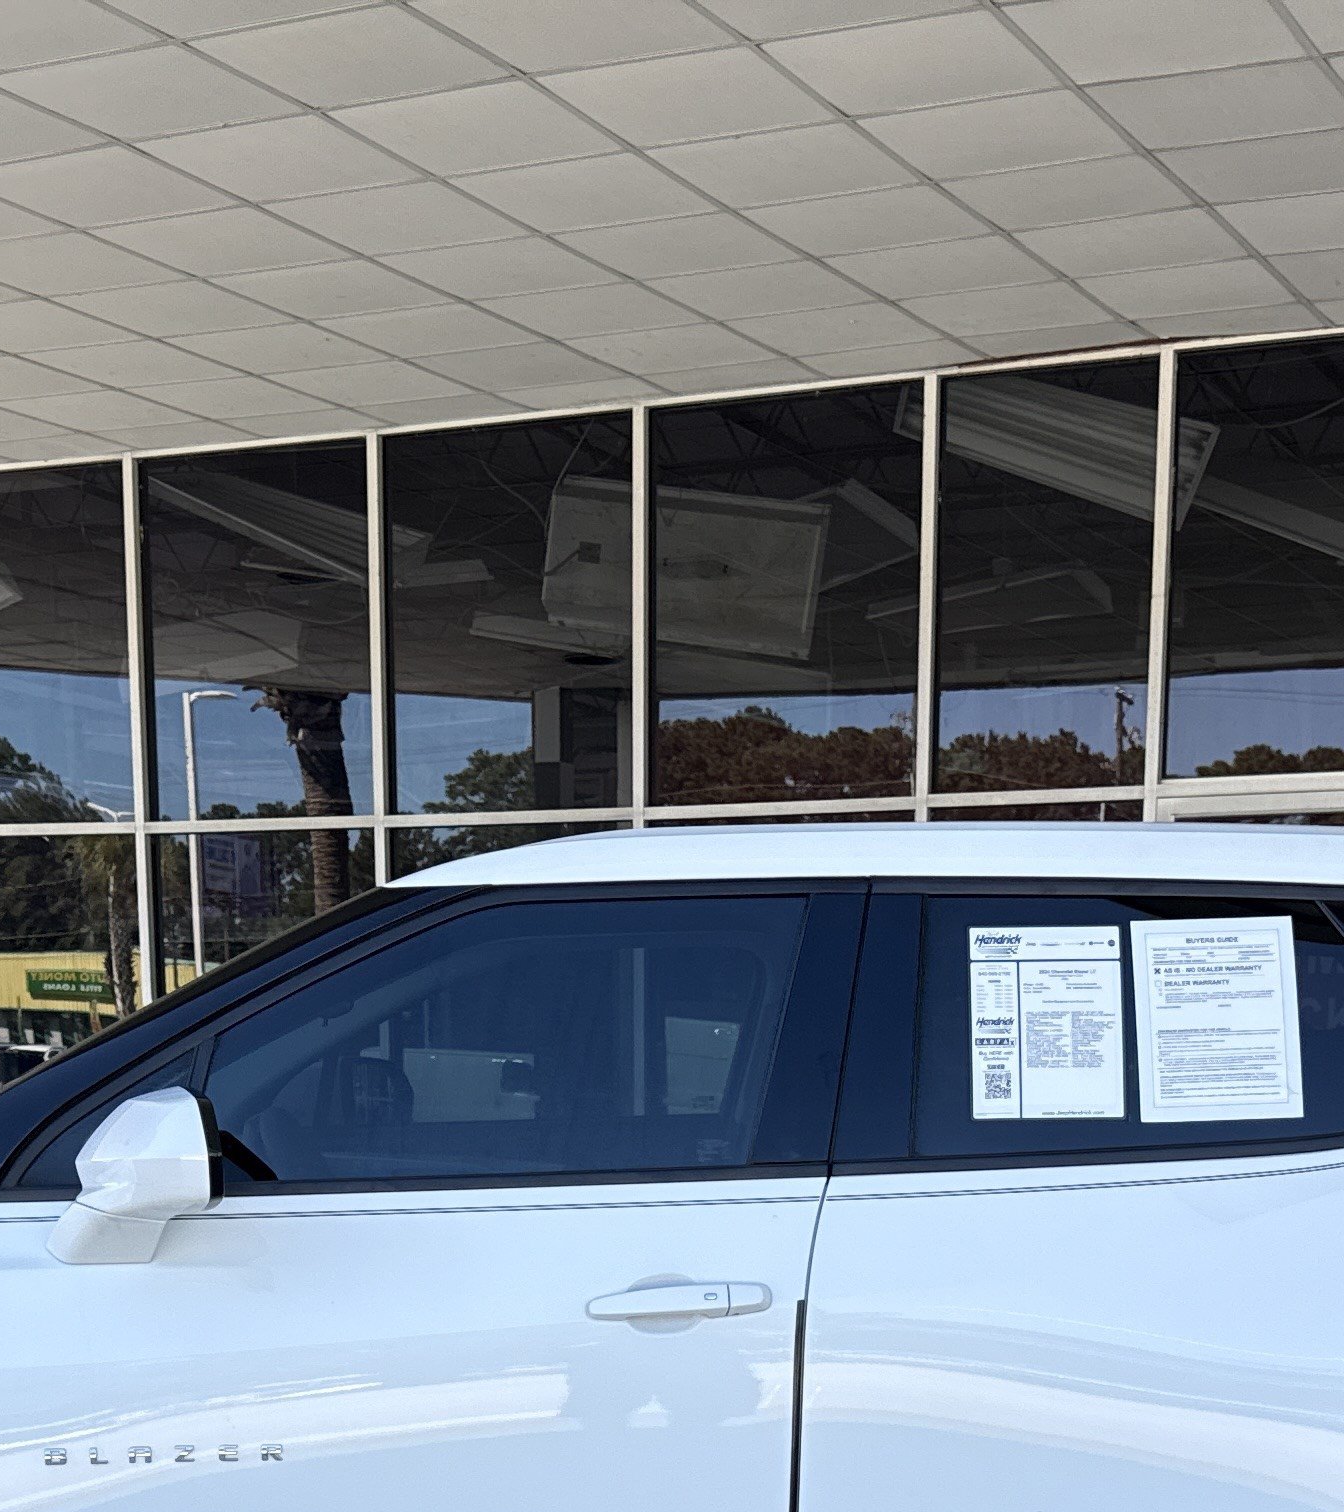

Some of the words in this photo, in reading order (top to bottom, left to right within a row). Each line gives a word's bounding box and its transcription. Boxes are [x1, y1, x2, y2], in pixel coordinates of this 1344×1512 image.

[974, 933, 1023, 948] Hendrick
[1196, 965, 1224, 973] DEALER
[1224, 964, 1262, 972] WARRANTY
[975, 1016, 1015, 1028] Hendrick
[43, 1443, 284, 1466] BLAZER
